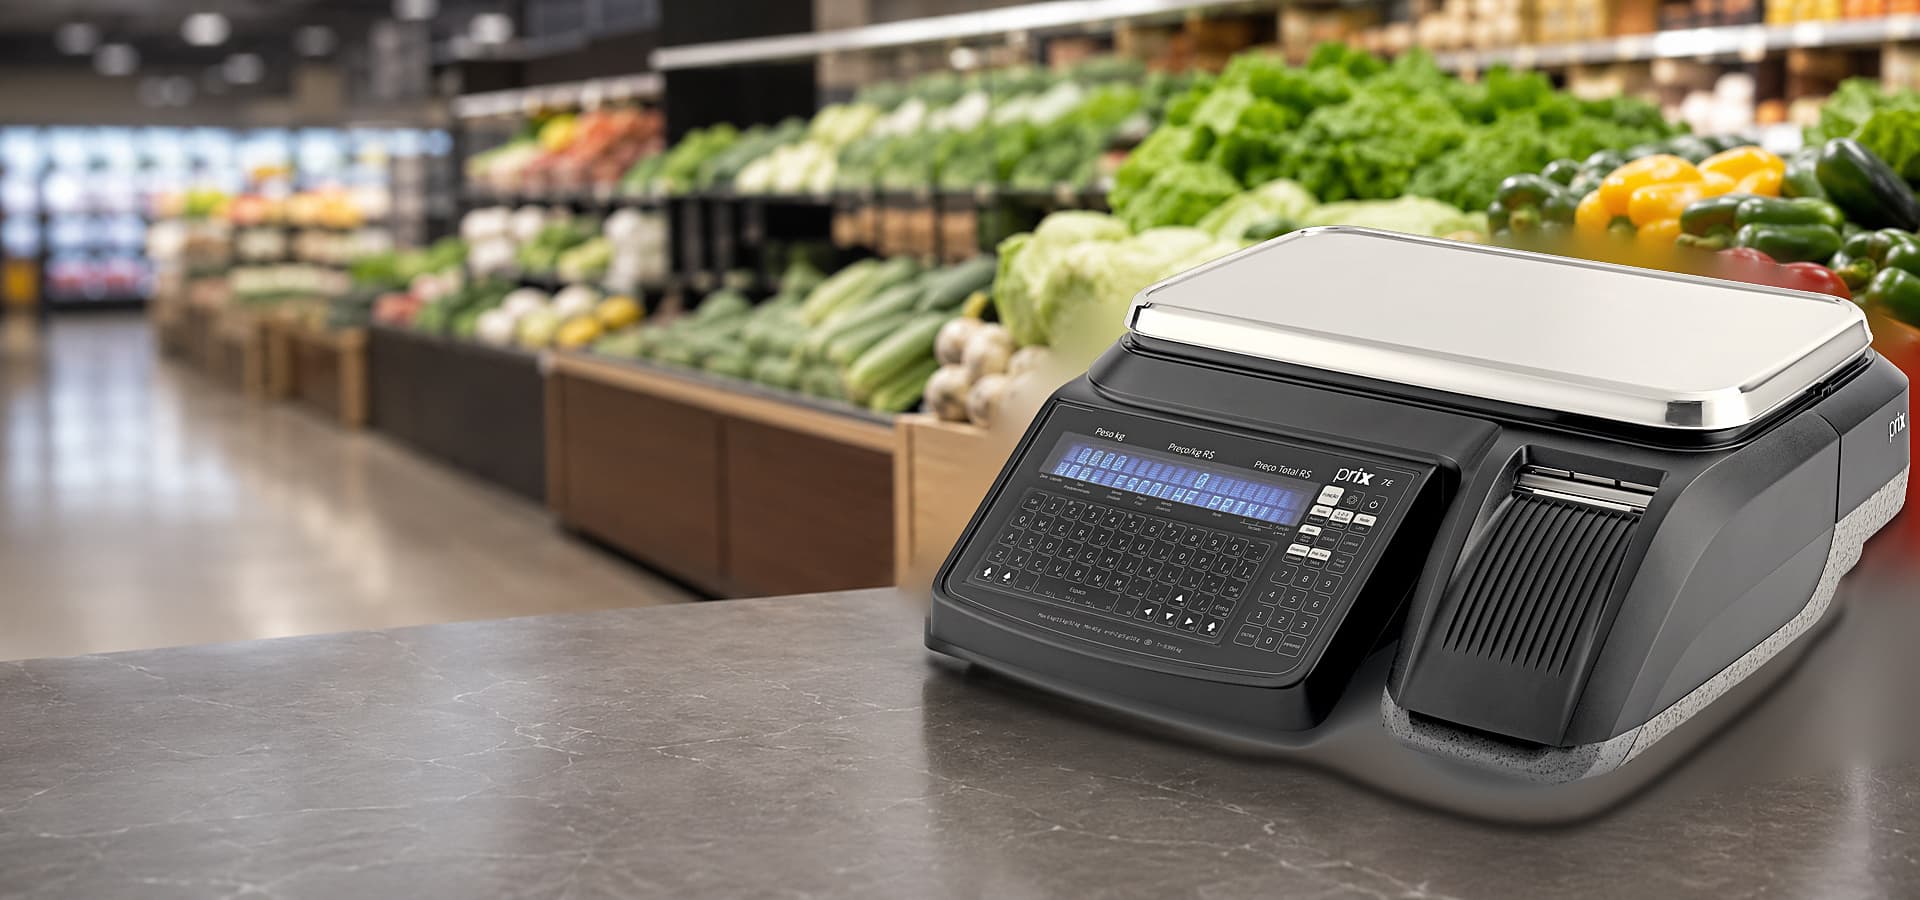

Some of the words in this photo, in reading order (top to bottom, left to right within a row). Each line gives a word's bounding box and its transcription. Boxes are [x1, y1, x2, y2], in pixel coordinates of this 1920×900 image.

[1095, 427, 1114, 439] Peso
[1114, 431, 1126, 442] kg
[1889, 411, 1906, 443] prix
[1167, 442, 1202, 458] Preço/kg
[1202, 449, 1216, 460] R$
[1253, 460, 1277, 473] Preço
[1278, 465, 1299, 476] Total
[1299, 469, 1313, 480] R$
[1332, 467, 1376, 486] prix
[1381, 478, 1394, 487] 7E
[1190, 534, 1197, 542] 8
[995, 550, 1003, 558] Z
[1074, 569, 1082, 577] B
[1094, 574, 1102, 582] N
[1280, 570, 1288, 578] 7
[1302, 575, 1309, 583] 8
[1324, 580, 1332, 588] 9
[1289, 595, 1297, 603] 5
[1312, 600, 1320, 608] 6
[1256, 611, 1262, 619] 1
[1277, 616, 1285, 624] 2
[1300, 621, 1308, 629] 3
[1265, 636, 1273, 645] 0
